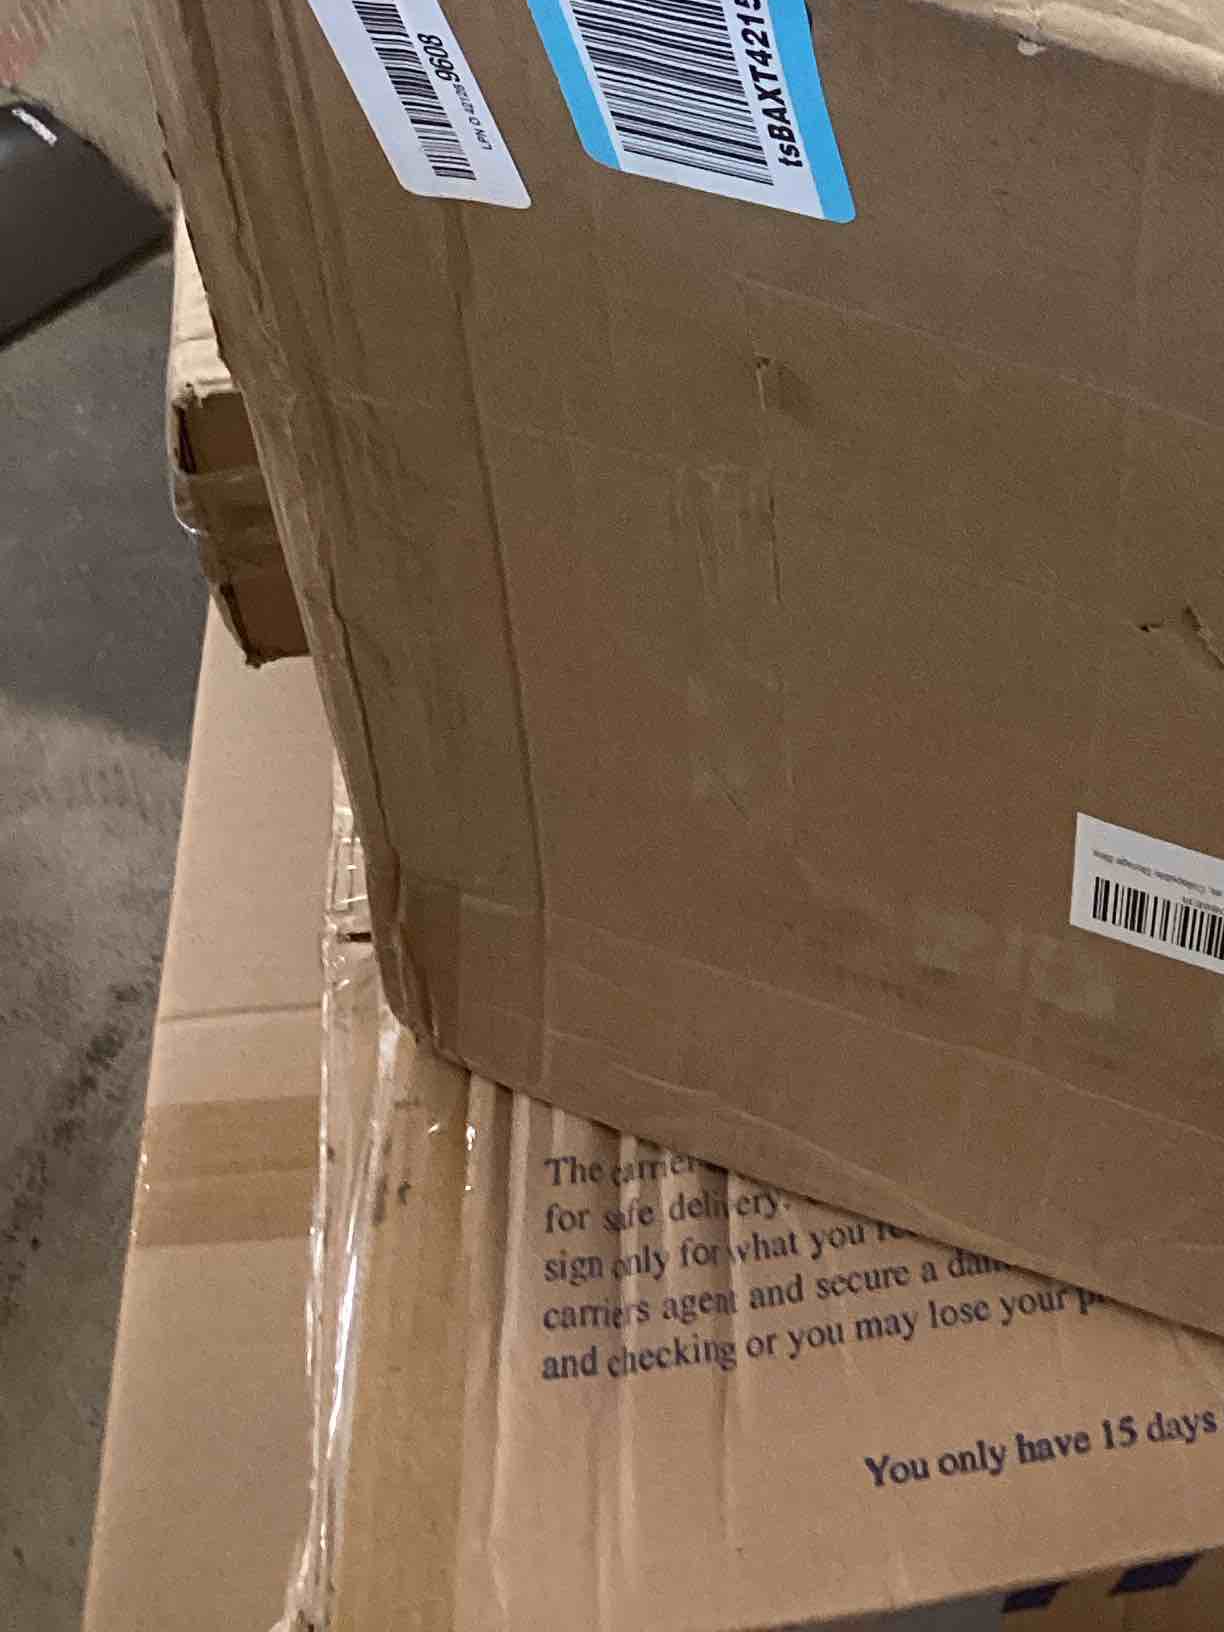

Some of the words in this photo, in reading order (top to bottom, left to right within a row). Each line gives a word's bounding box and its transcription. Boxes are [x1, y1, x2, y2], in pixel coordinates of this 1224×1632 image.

[417, 32, 461, 83] 9608
[543, 1154, 604, 1186] The
[544, 1201, 591, 1234] for
[543, 1248, 604, 1287] sign
[610, 1244, 666, 1281] only
[679, 1236, 722, 1267] for
[809, 1222, 865, 1261] you
[661, 1287, 738, 1325] agent
[749, 1273, 804, 1309] and
[815, 1264, 911, 1300] secure
[921, 1260, 939, 1283] a
[541, 1345, 600, 1380] and
[606, 1331, 738, 1378] checking
[745, 1332, 778, 1358] or
[787, 1322, 844, 1360] you
[854, 1311, 919, 1342] may
[928, 1299, 992, 1329] lose
[1000, 1287, 1068, 1327] your
[863, 1455, 931, 1488] You
[937, 1439, 1007, 1477] only
[1015, 1431, 1092, 1466] have
[1102, 1415, 1139, 1451] 15
[1146, 1411, 1218, 1445] days
